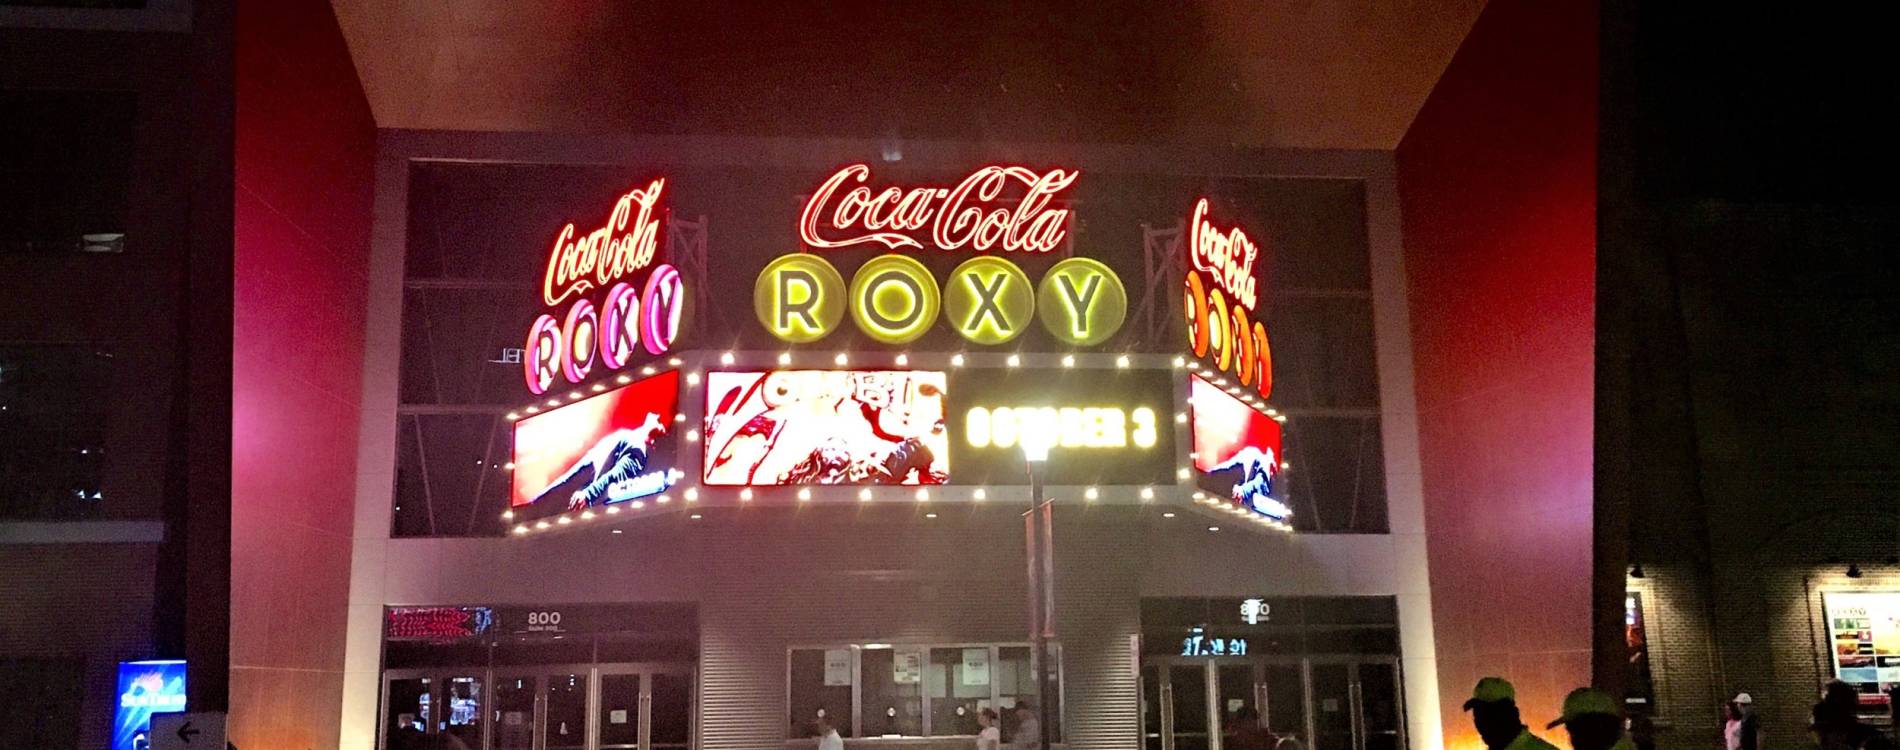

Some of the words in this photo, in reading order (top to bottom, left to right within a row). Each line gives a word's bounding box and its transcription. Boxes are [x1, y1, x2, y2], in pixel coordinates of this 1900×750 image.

[800, 164, 1079, 252] Coca-Cola
[533, 270, 682, 390] ROXY
[775, 269, 1103, 337] ROXY
[1132, 407, 1157, 448] 3
[528, 611, 561, 625] 800
[1240, 603, 1270, 615] 80
